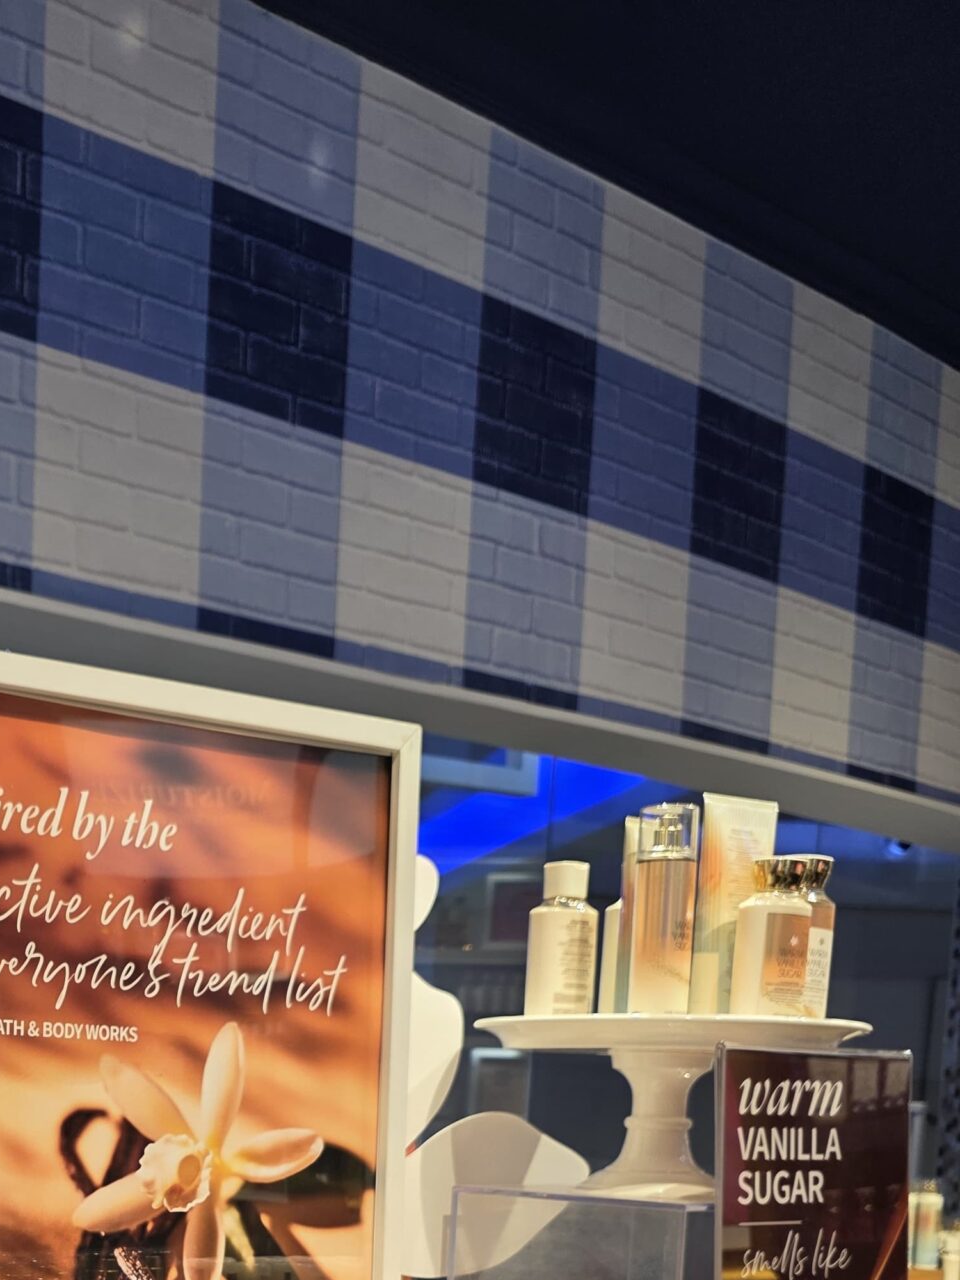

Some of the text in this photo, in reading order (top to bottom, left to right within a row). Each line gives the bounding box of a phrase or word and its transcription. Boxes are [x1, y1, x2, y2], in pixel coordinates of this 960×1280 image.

[72, 791, 115, 860] by
[122, 799, 178, 851] the
[100, 887, 308, 966] ingredient
[171, 943, 280, 1014] trend
[286, 945, 348, 1016] list
[28, 1020, 39, 1037] &
[42, 1021, 85, 1040] BODY
[86, 1024, 139, 1043] WORKS
[738, 1077, 844, 1118] warm
[737, 1126, 842, 1161] VANILLA
[737, 1170, 825, 1205] SUGAR
[741, 1227, 852, 1280] smells like
